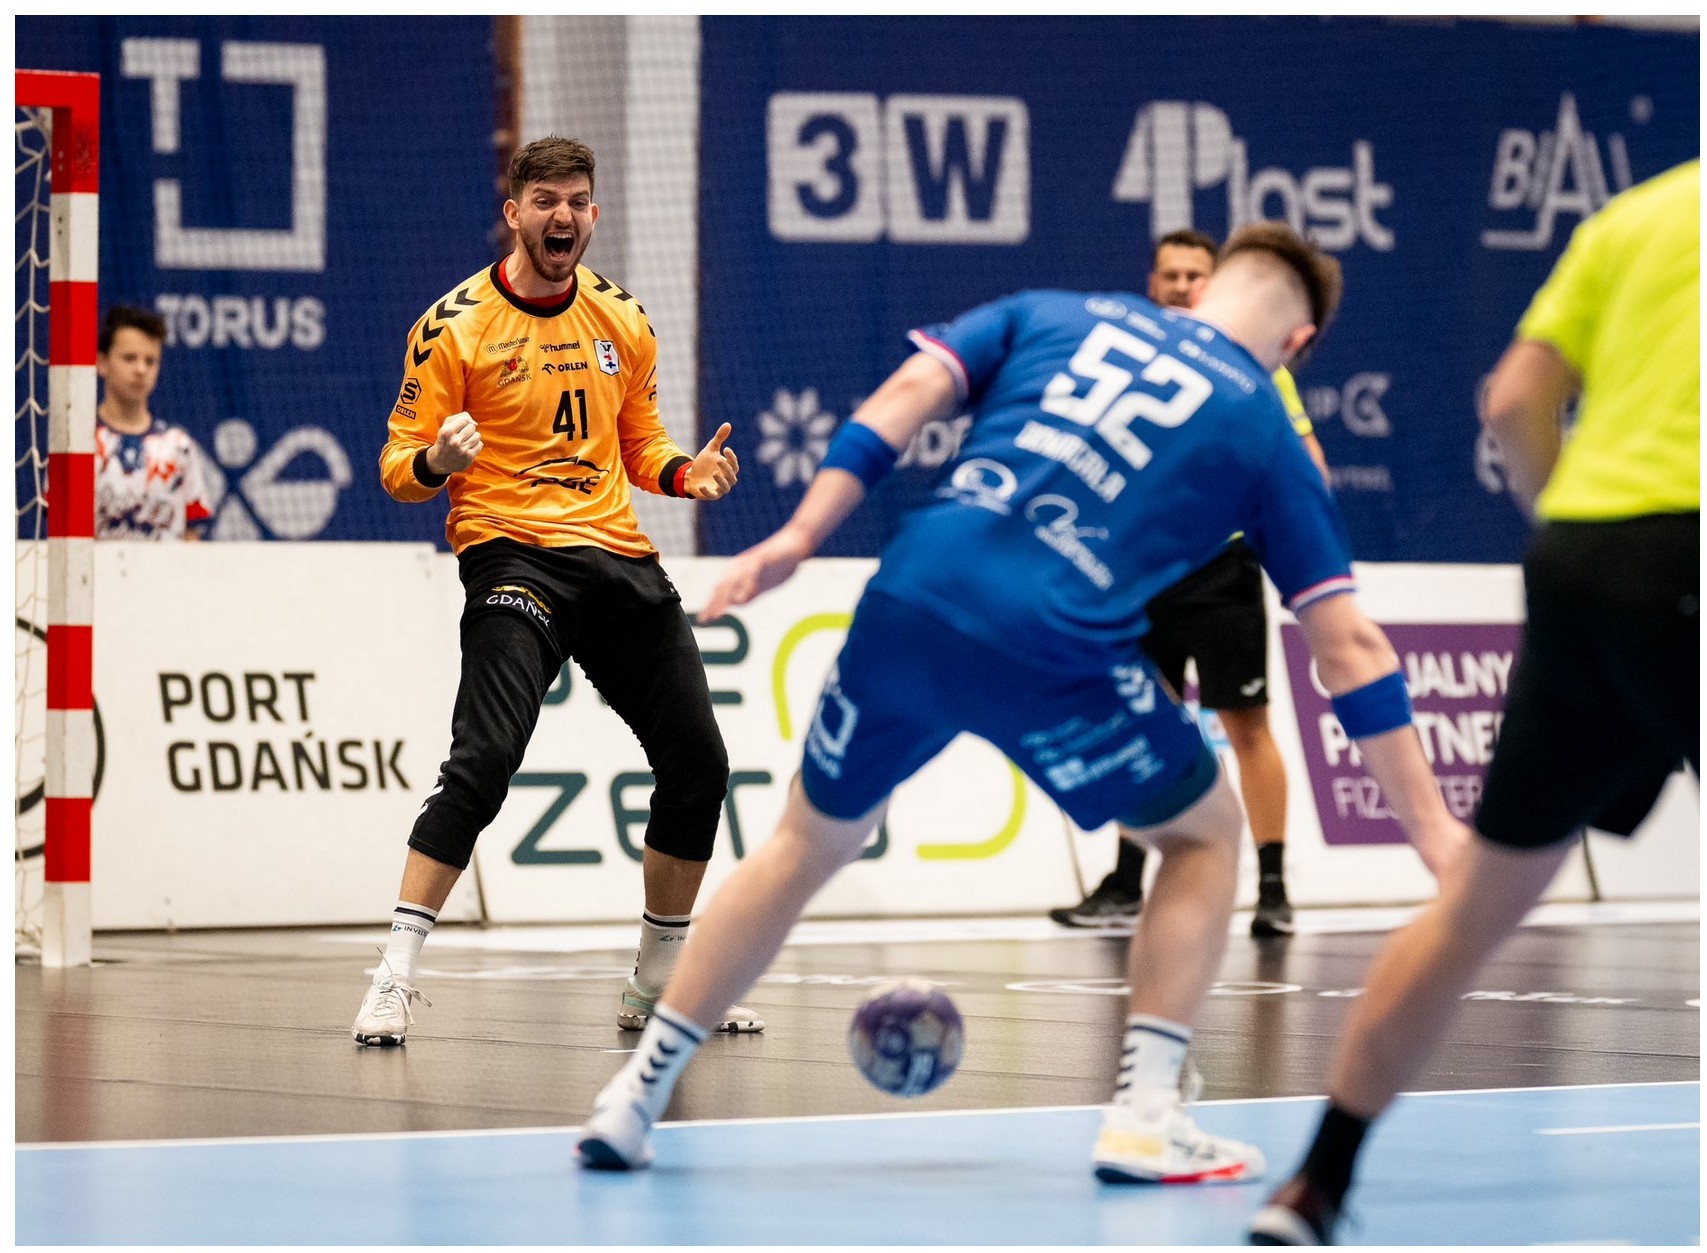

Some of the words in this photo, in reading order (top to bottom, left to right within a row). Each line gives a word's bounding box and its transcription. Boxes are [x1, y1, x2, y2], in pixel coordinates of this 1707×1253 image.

[792, 108, 1009, 223] 3W
[155, 294, 327, 349] TORUS
[549, 340, 581, 352] hummel
[558, 361, 588, 372] ORLEN
[396, 405, 416, 419] ORLEN
[552, 388, 589, 442] 41
[1040, 321, 1214, 471] 52
[158, 671, 316, 723] PORT
[167, 728, 411, 794] GDAŃSK
